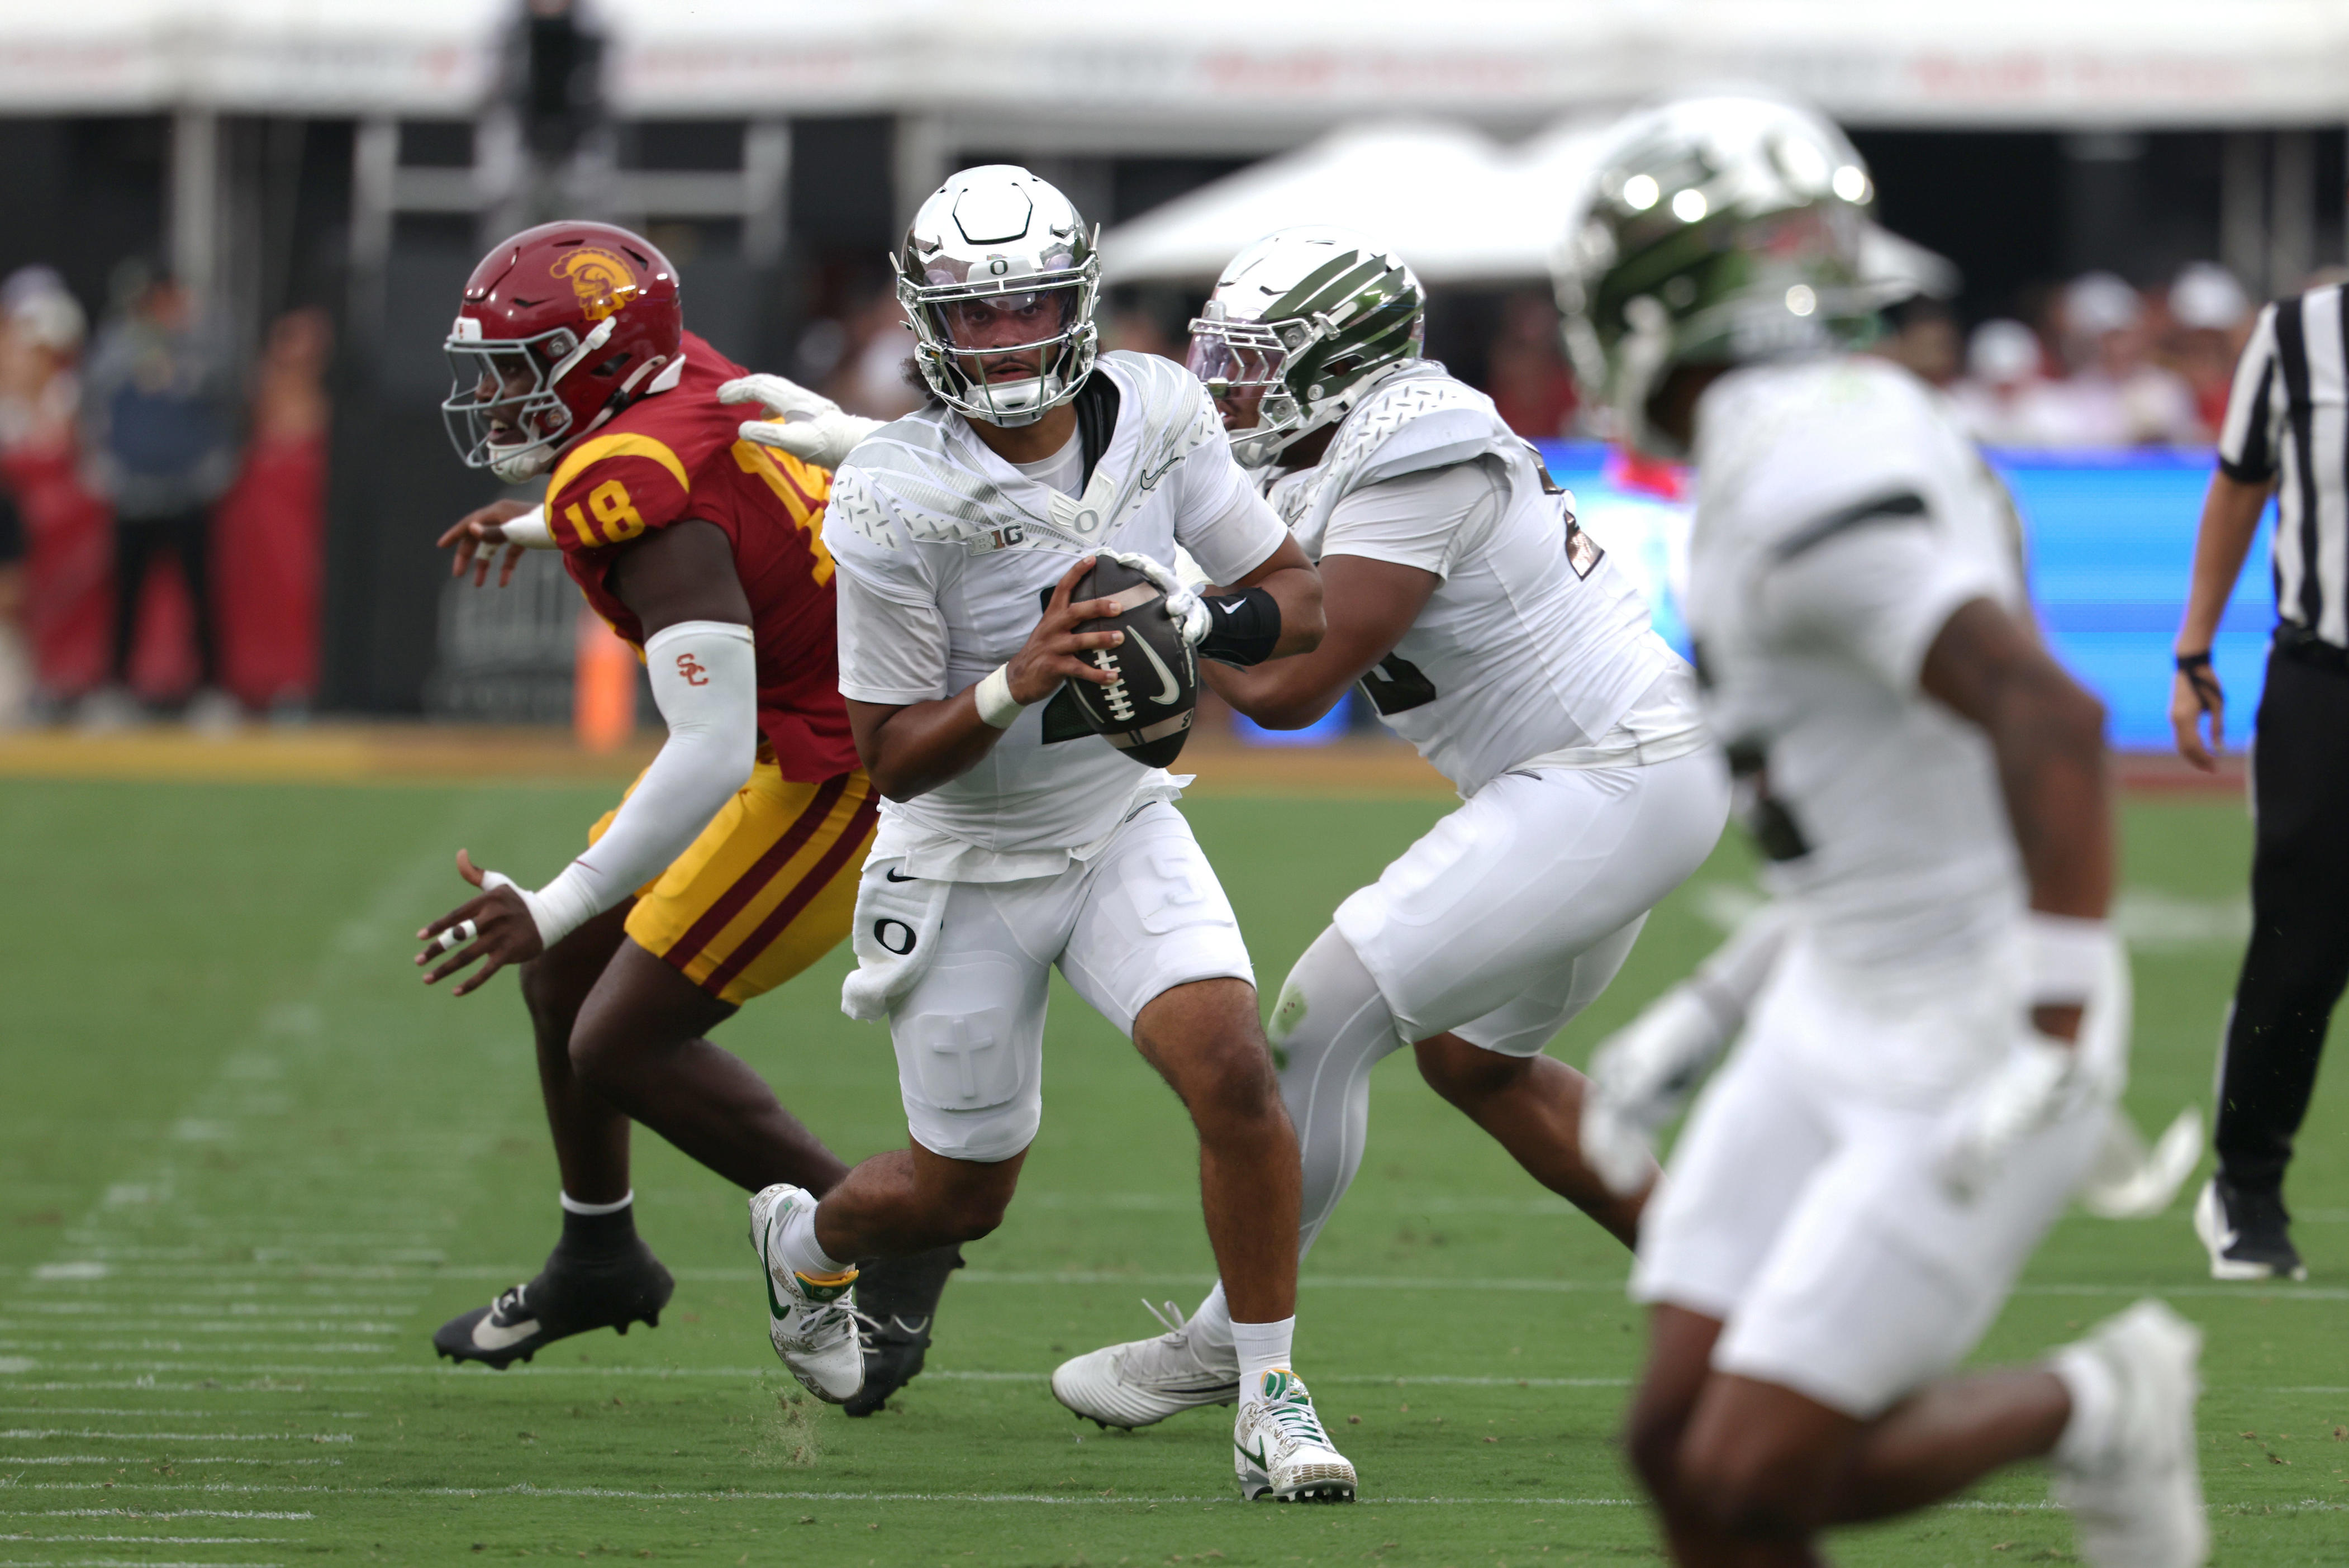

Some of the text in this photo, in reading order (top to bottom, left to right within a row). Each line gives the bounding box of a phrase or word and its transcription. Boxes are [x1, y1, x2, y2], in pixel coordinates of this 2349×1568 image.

[990, 260, 1008, 275] O
[564, 479, 645, 548] 18
[1074, 509, 1099, 533] O
[677, 653, 708, 686] SC
[874, 919, 916, 955] O
